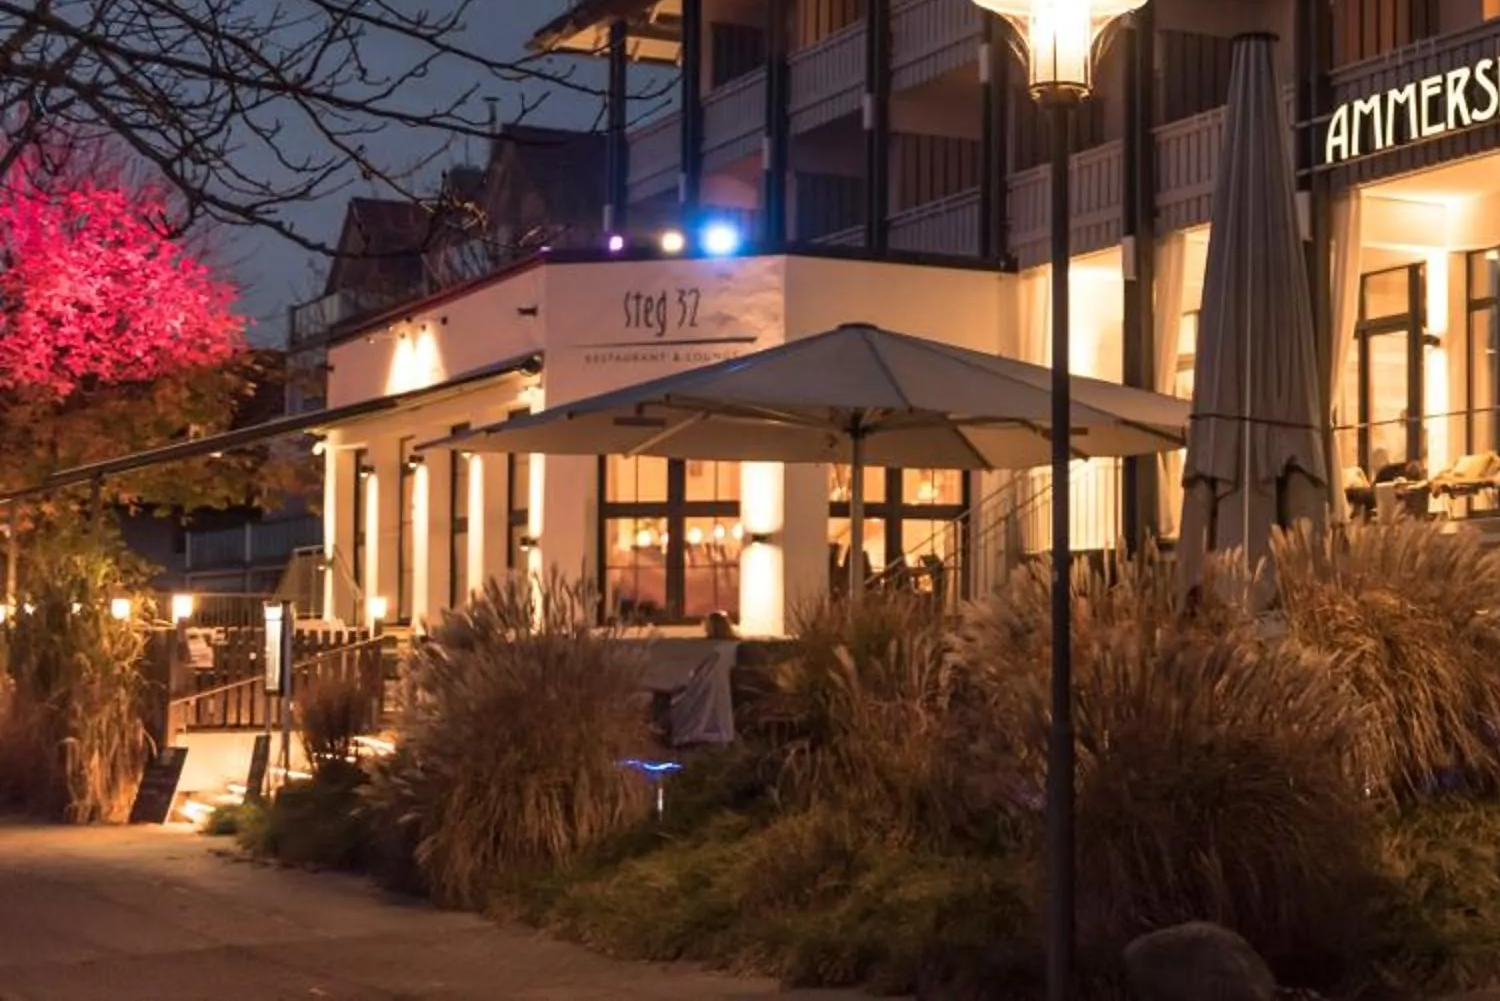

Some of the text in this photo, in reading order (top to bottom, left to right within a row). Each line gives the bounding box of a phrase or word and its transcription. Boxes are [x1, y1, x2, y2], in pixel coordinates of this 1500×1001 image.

[624, 287, 702, 337] steg 32
[585, 350, 666, 364] RESTAURANT
